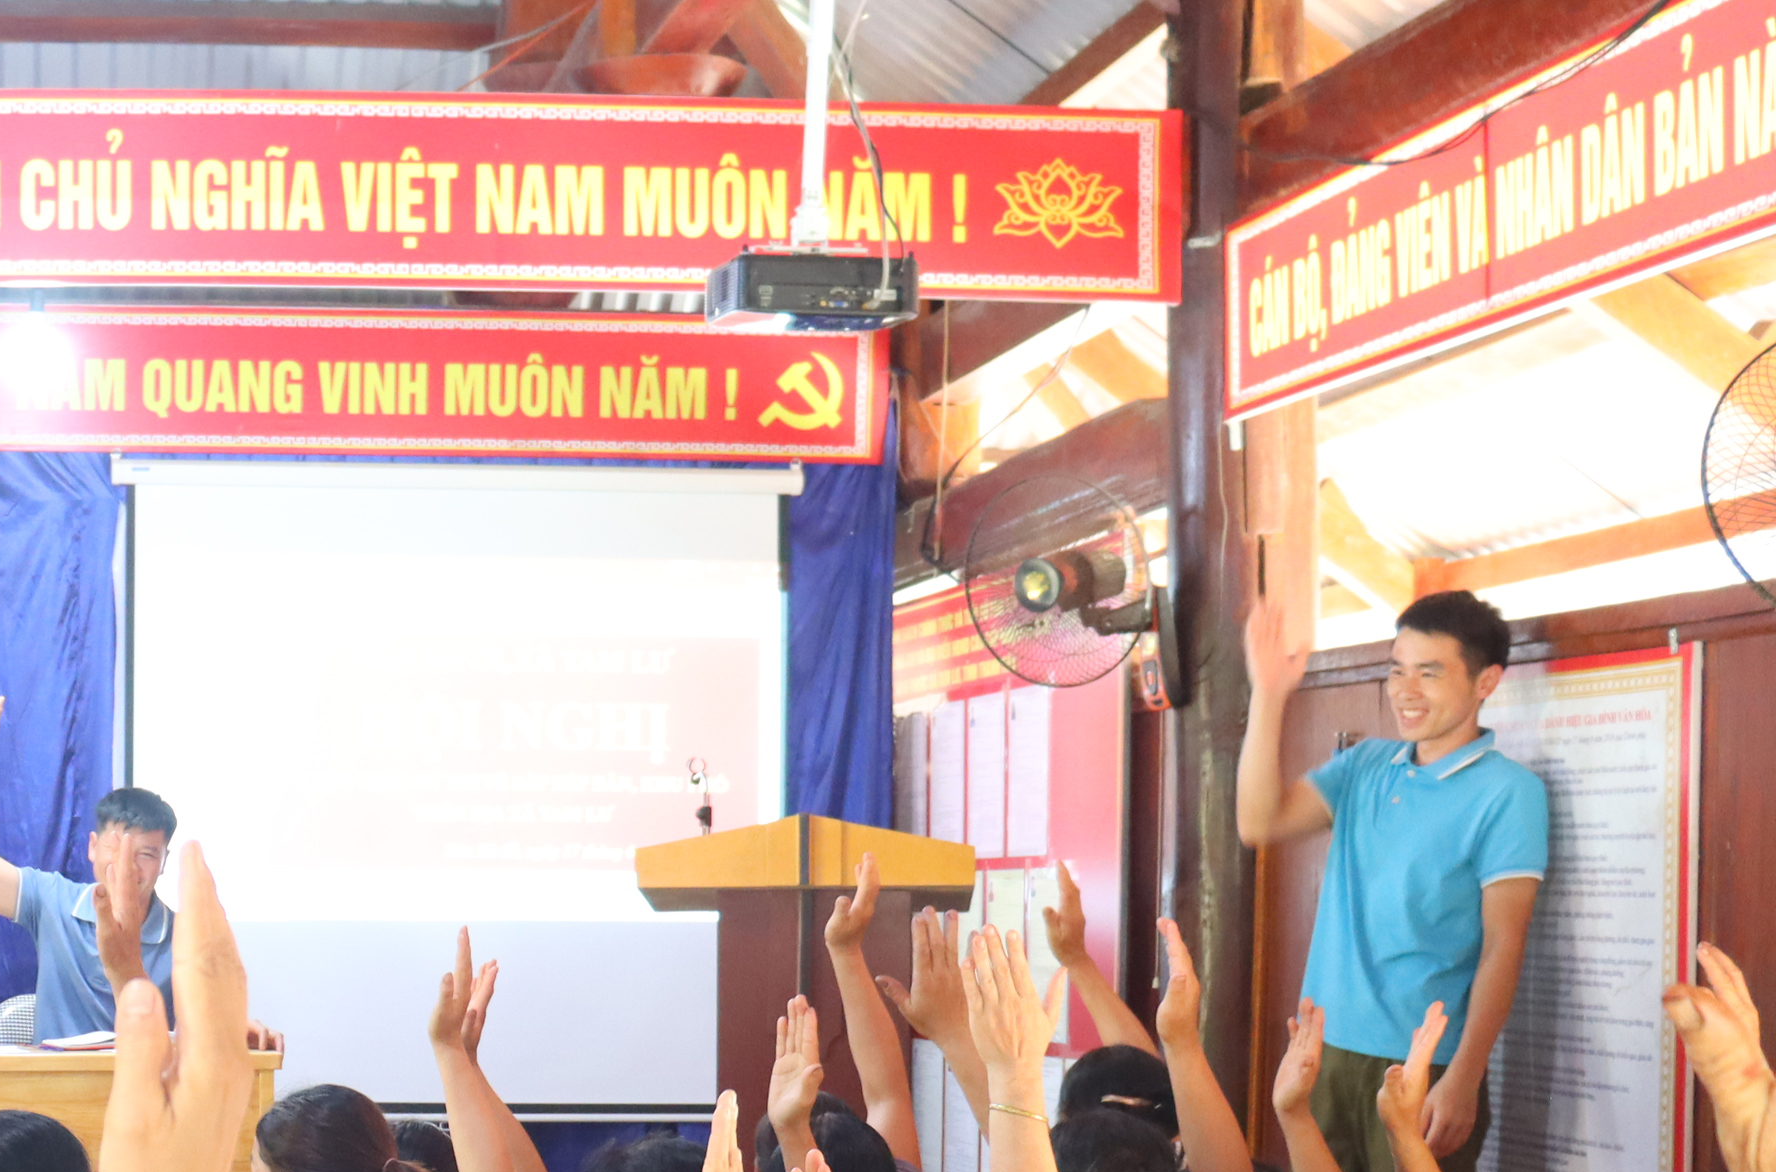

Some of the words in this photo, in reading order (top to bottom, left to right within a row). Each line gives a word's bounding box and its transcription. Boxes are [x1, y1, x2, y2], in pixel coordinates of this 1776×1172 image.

[20, 129, 132, 231] CHỦ
[150, 146, 325, 231] NGHĨA
[341, 147, 459, 249] VIỆT
[476, 163, 604, 236] NAM
[623, 153, 787, 240] MUÔN
[1249, 255, 1290, 357] CÁN
[1293, 233, 1328, 352] BỘ,
[1330, 197, 1392, 325] ĐẢNG
[1395, 181, 1451, 298] VIÊN
[1455, 156, 1490, 274] VÀ
[1495, 125, 1574, 260] NHÂN
[1581, 92, 1645, 227] DÂN
[1654, 33, 1725, 196] BẢN
[16, 358, 126, 411] AM
[142, 358, 303, 418] QUANG
[318, 361, 428, 415] VINH
[444, 353, 584, 417] MUÔN
[600, 356, 707, 420] NĂM
[498, 701, 671, 765] NGHỊ
